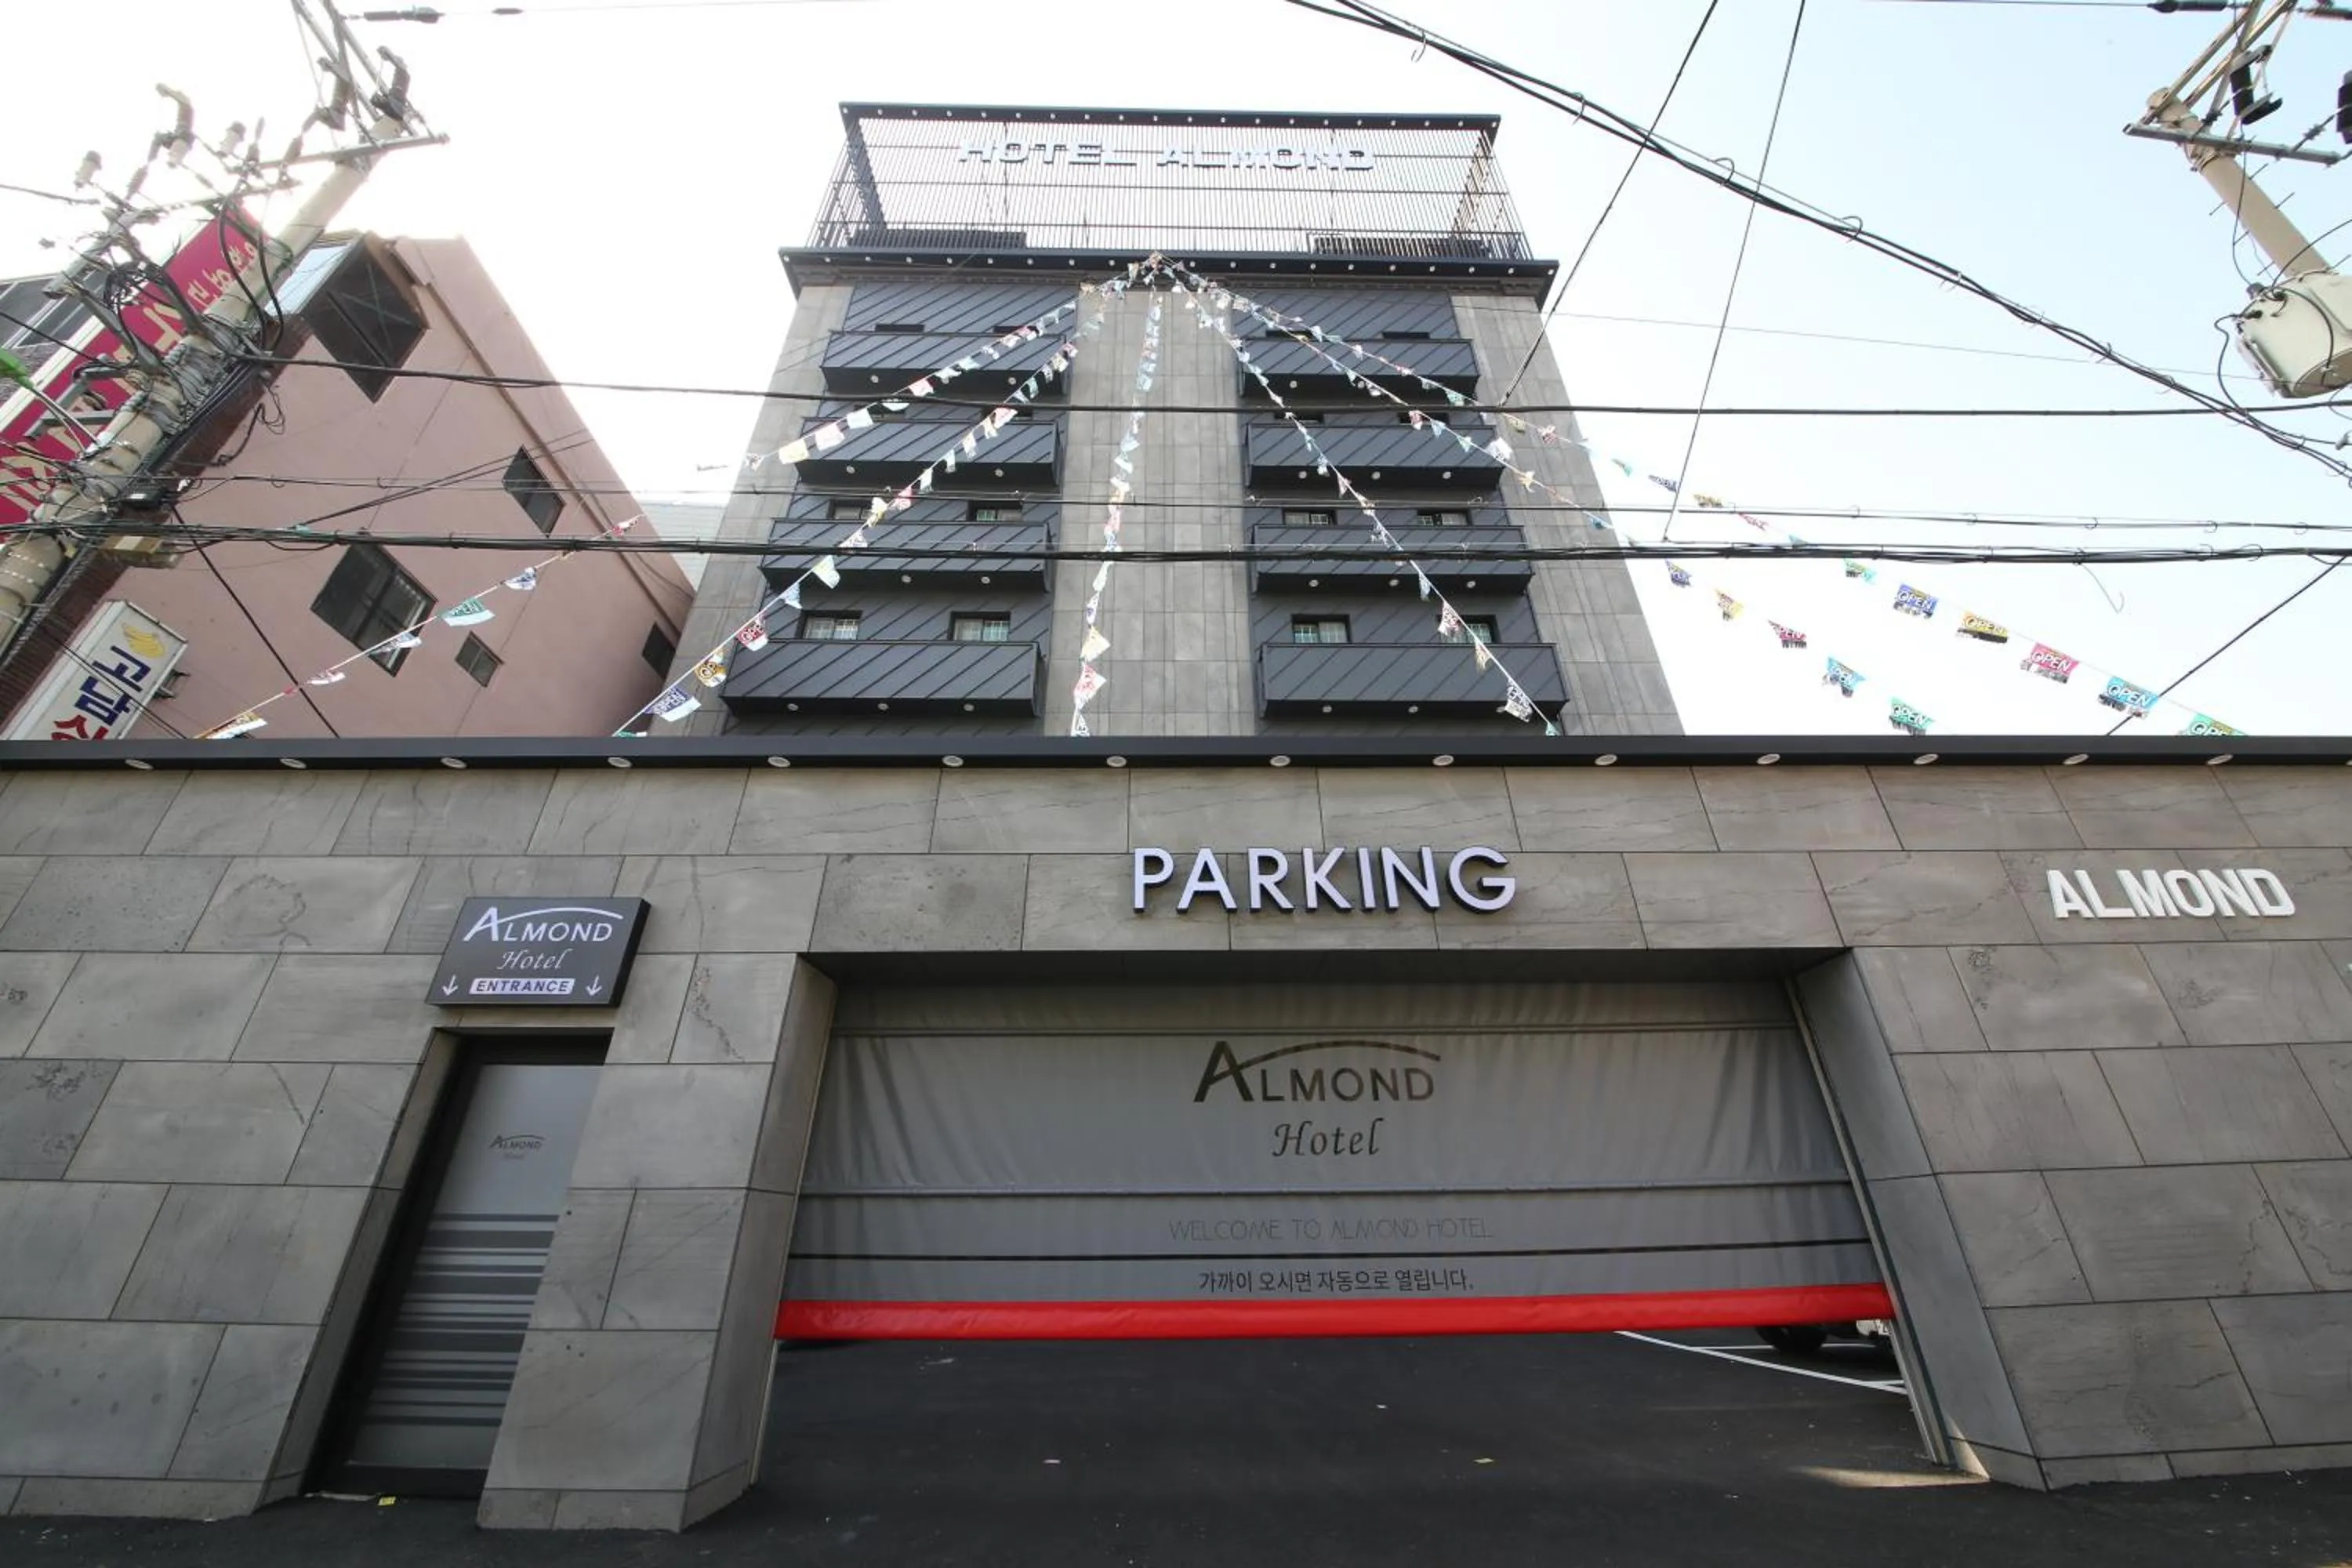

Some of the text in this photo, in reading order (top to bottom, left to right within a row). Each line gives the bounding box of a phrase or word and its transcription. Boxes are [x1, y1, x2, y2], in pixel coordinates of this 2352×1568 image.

[958, 140, 1374, 170] HOTEL ALMOND
[1897, 590, 1935, 610] OPEN
[1964, 616, 2007, 634] OPEN
[2031, 651, 2072, 672] OPEN
[2107, 684, 2151, 706] OPEN
[1132, 845, 1517, 913] PARKING
[2046, 868, 2296, 918] ALMOND
[463, 906, 615, 942] ALMOND
[496, 947, 573, 971] Hotel
[475, 980, 568, 993] ENTRANCE
[1193, 1040, 1435, 1102] ALMOND
[1271, 1117, 1385, 1157] Hotel
[1169, 1217, 1495, 1242] WELCOME TO ALMOND HOTEL
[1198, 1267, 1475, 1294] 가까이 오시면 자동으로 열립니다.
